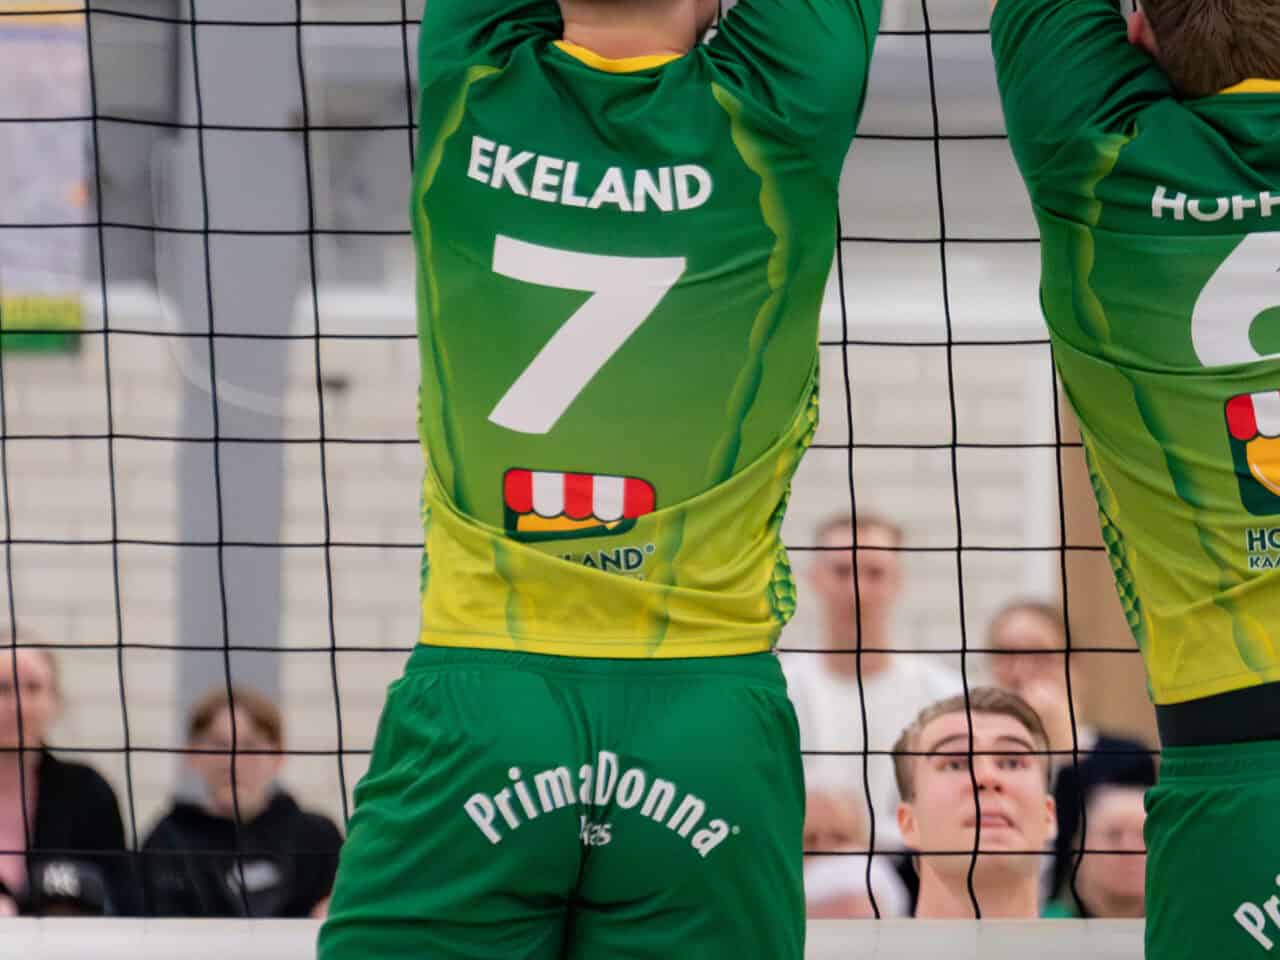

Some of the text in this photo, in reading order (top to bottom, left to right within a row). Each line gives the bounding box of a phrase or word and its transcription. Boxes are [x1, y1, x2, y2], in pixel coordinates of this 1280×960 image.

[466, 135, 713, 212] EKELAND
[487, 233, 687, 435] 7
[463, 750, 731, 858] PrimaDonna
